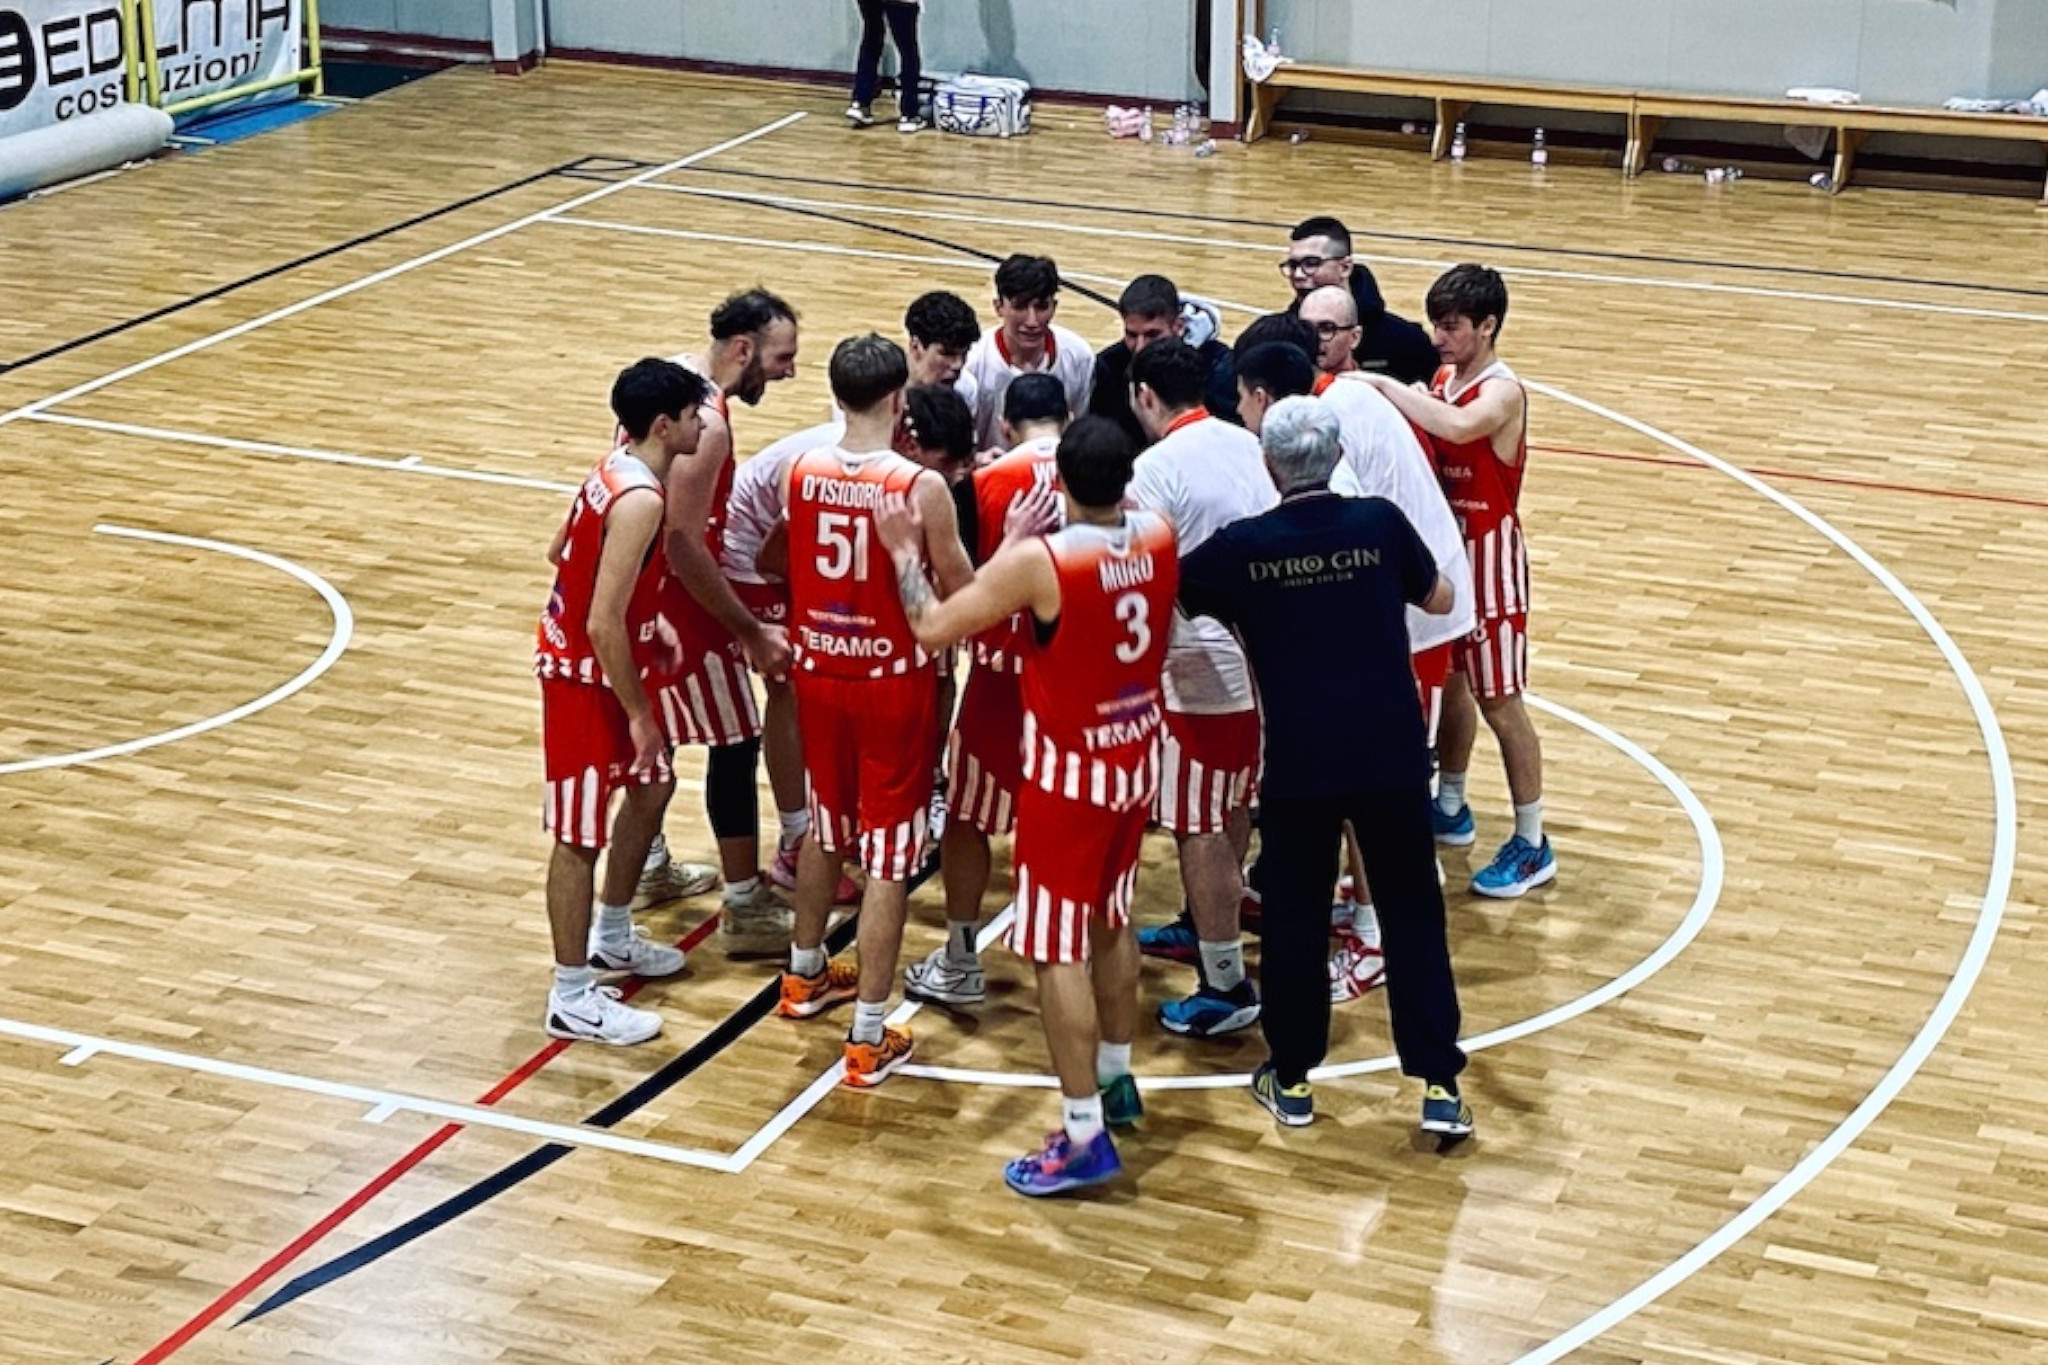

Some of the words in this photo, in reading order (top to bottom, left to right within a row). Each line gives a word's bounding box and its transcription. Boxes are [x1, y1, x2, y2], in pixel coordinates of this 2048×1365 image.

[816, 510, 869, 582] 51
[1250, 555, 1324, 582] DYRO
[1331, 548, 1381, 570] GIN
[798, 625, 894, 658] TERAMO
[1114, 590, 1151, 664] 3
